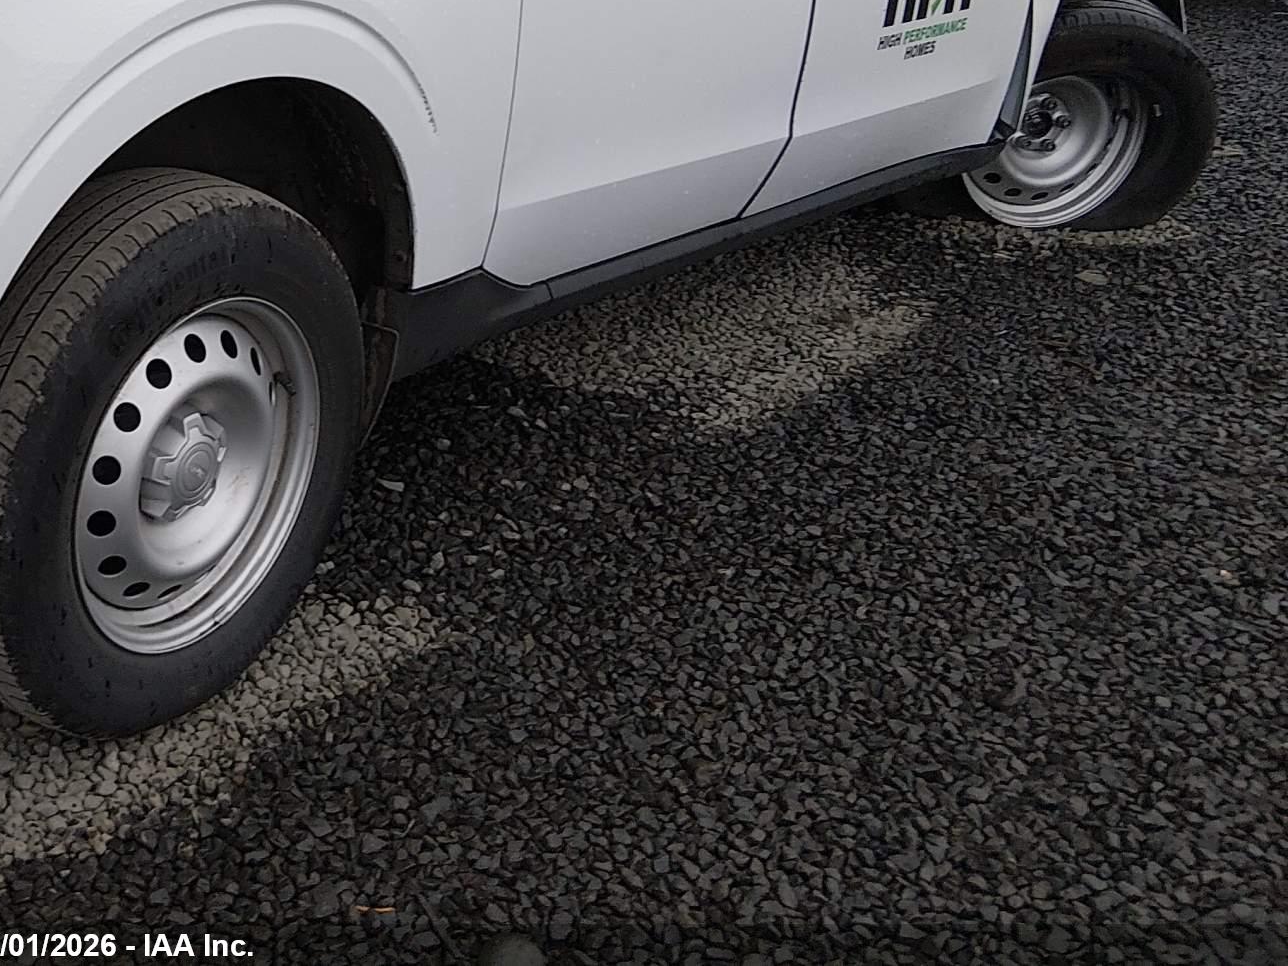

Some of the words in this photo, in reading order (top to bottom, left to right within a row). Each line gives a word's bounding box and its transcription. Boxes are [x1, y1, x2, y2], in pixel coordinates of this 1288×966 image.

[877, 32, 903, 51] HIGH
[903, 17, 968, 45] PERFORMANCE
[903, 40, 936, 60] HOMES
